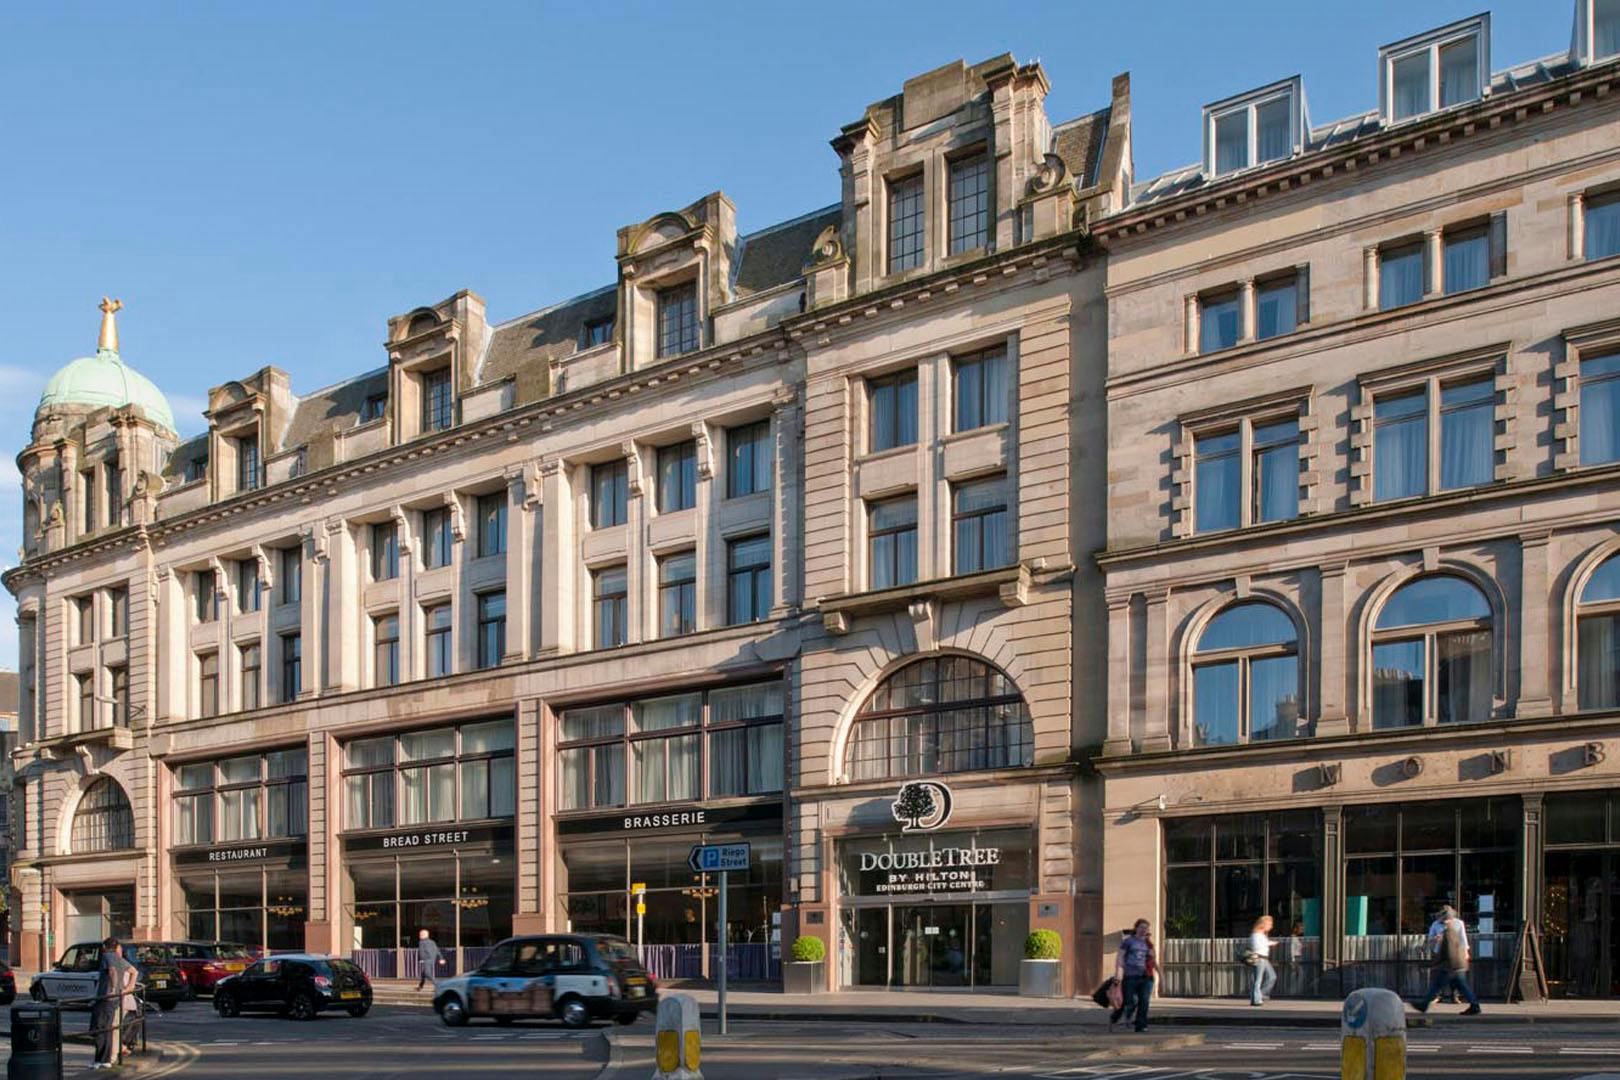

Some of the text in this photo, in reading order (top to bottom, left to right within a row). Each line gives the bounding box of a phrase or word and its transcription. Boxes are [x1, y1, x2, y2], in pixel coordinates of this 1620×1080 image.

[624, 811, 705, 829] BRASSERIE
[383, 831, 469, 848] BREAD STREET
[208, 847, 268, 861] RESTAURANT
[722, 847, 746, 858] Riego
[720, 858, 746, 867] Street
[889, 871, 970, 883] BY HILTON
[876, 882, 925, 892] EDINBURGH
[927, 881, 947, 890] CITY
